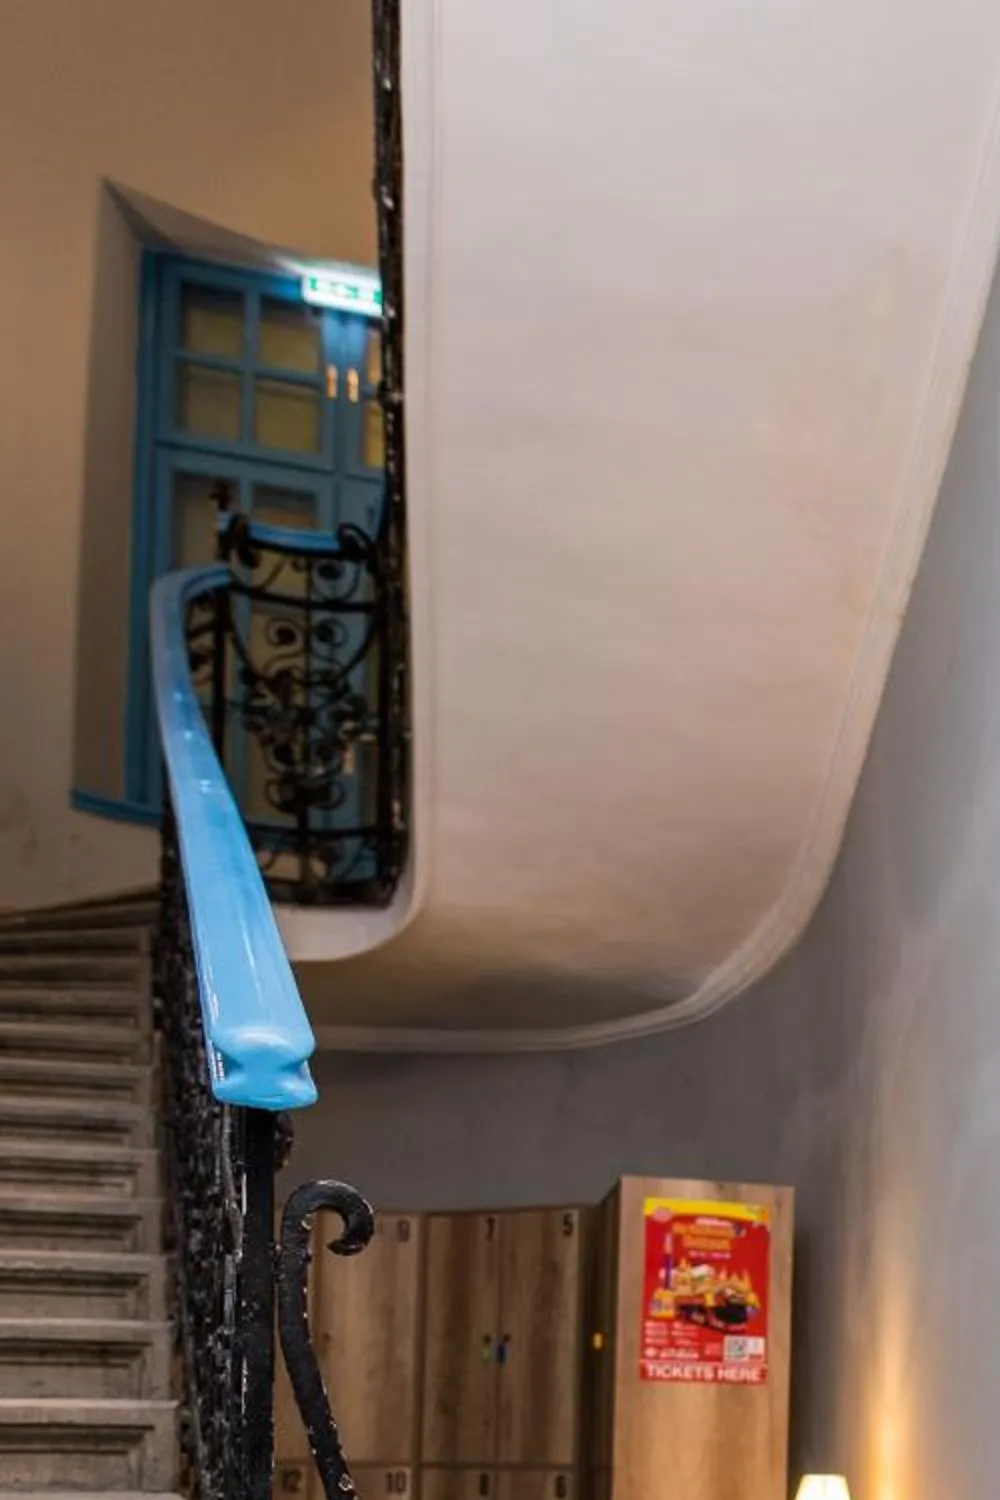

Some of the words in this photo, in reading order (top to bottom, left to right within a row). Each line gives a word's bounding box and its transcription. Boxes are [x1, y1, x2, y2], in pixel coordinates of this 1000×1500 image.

[562, 1212, 574, 1237] 5
[645, 1362, 714, 1380] TICKETS
[717, 1365, 762, 1382] HERE
[282, 1470, 302, 1492] 12
[385, 1471, 406, 1494] 10
